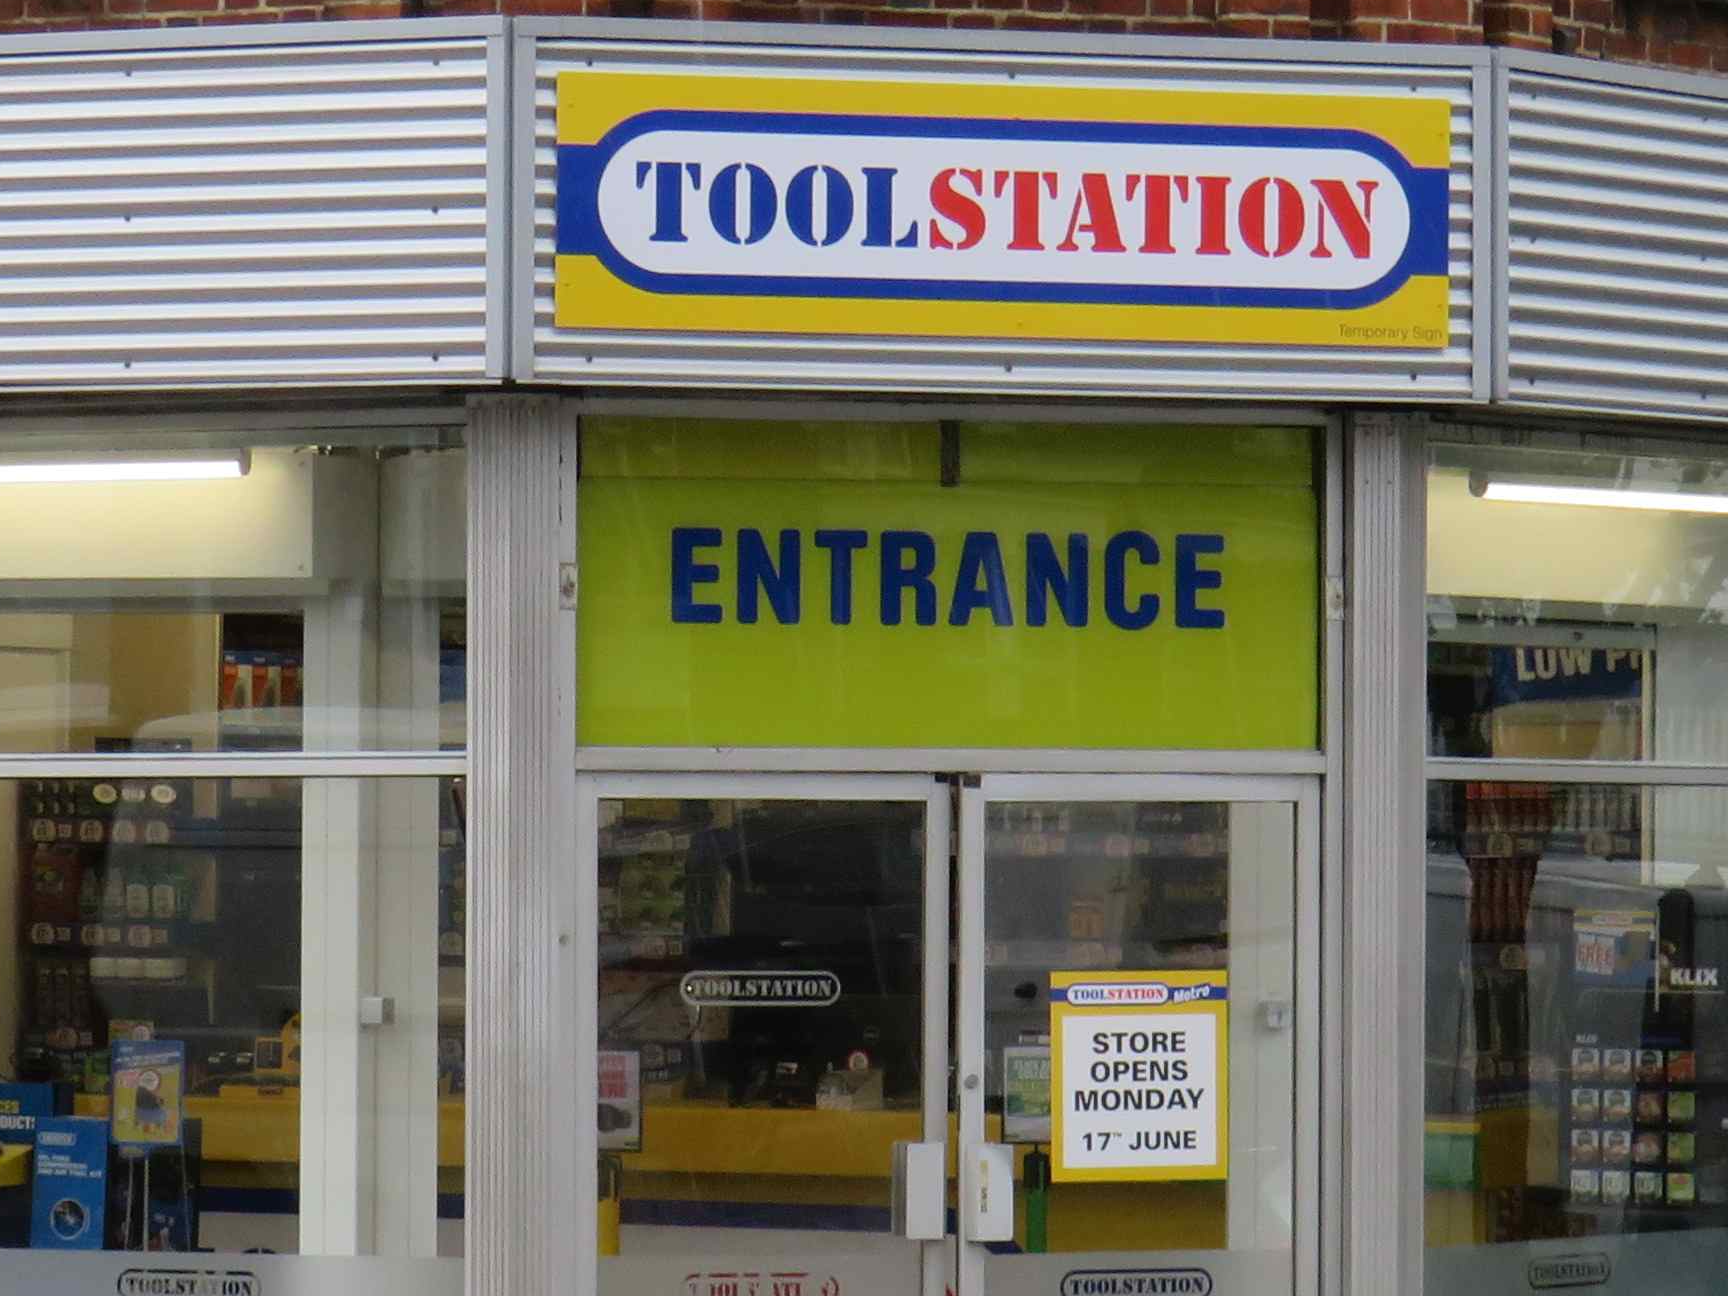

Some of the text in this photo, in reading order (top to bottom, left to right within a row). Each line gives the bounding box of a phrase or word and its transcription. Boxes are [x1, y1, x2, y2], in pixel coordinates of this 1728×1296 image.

[636, 161, 1378, 260] TOOLSTATION
[1338, 323, 1442, 342] Temporary Sign
[671, 526, 1225, 629] ENTRANCE
[1670, 967, 1718, 986] KLIX
[692, 978, 832, 998] TOOLSTATION
[1072, 985, 1210, 1003] TOOLSTATION Metro
[1092, 1031, 1186, 1054] STORE
[1090, 1059, 1189, 1083] OPENS
[1074, 1088, 1205, 1112] MONDAY
[1129, 1130, 1197, 1151] JUNE
[1070, 1277, 1204, 1296] TOOLSTATION
